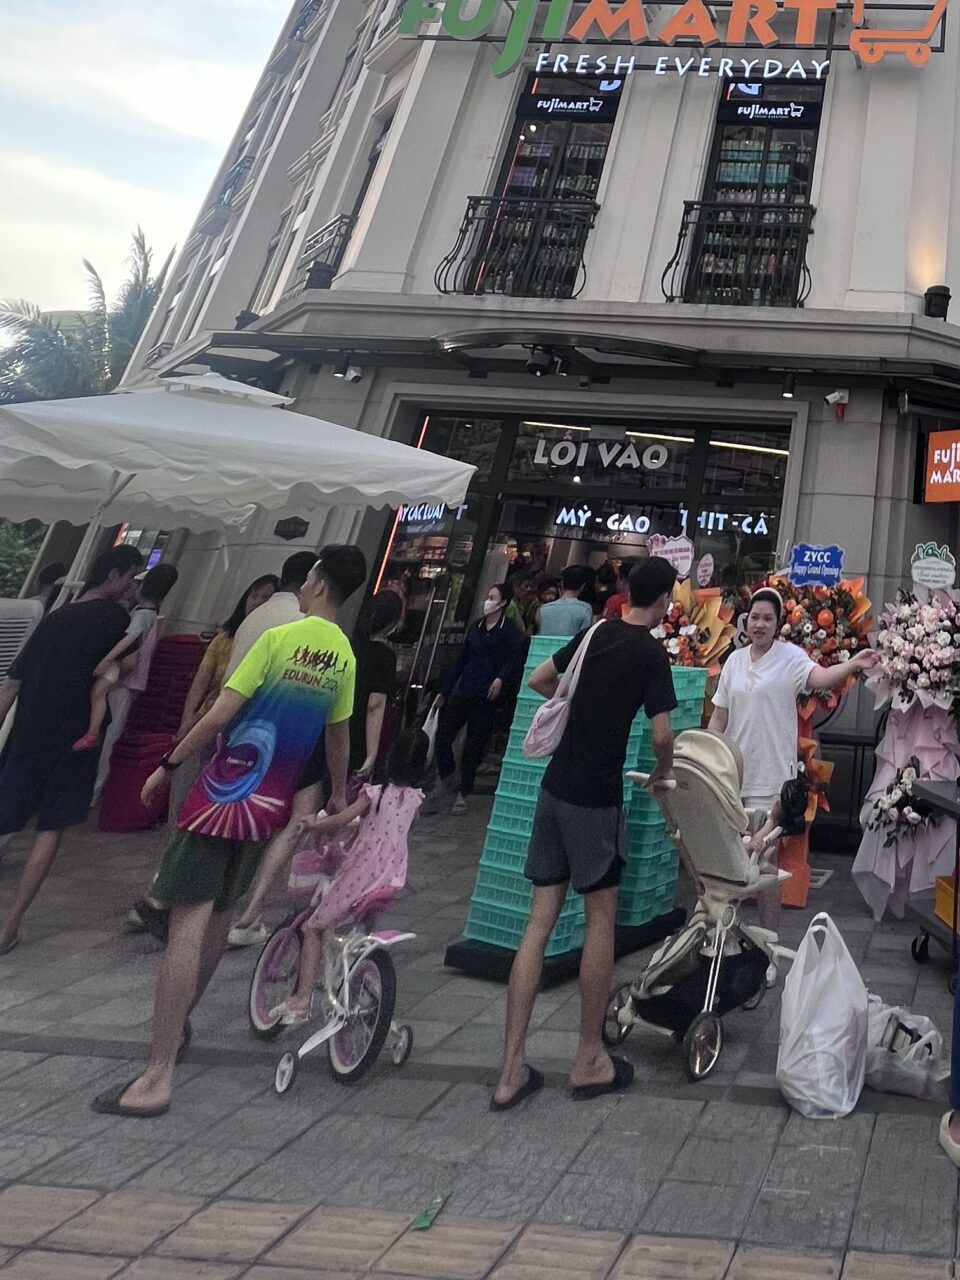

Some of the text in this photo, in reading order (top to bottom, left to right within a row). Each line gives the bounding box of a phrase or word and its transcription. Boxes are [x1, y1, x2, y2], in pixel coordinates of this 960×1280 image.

[535, 52, 831, 81] FRESH EVERYDAY
[598, 437, 668, 470] VÀO
[606, 513, 650, 536] GẠO
[803, 550, 832, 563] ZYCC
[282, 668, 322, 687] EDURUN
